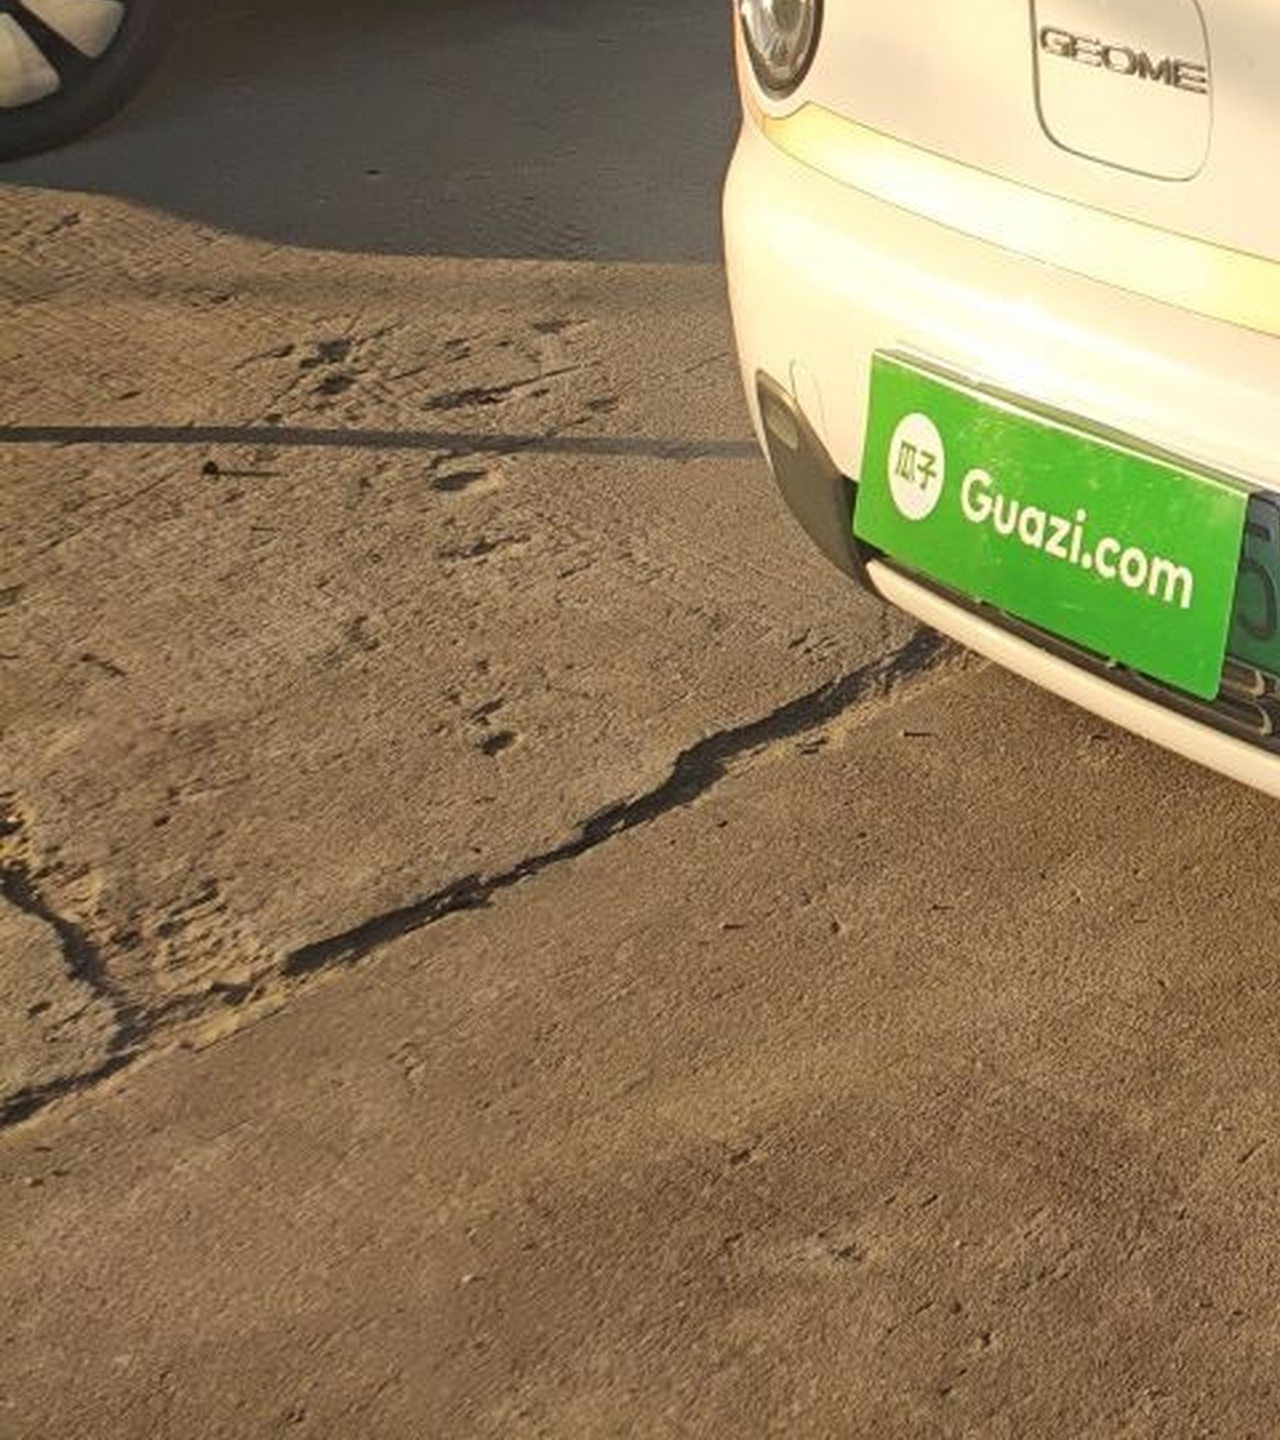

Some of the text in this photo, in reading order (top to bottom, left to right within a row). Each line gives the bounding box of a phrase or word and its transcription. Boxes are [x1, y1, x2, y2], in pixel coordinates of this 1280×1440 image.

[1040, 26, 1208, 95] GEOME
[895, 440, 938, 491] 瓜子
[960, 468, 1194, 610] Guazi.com
